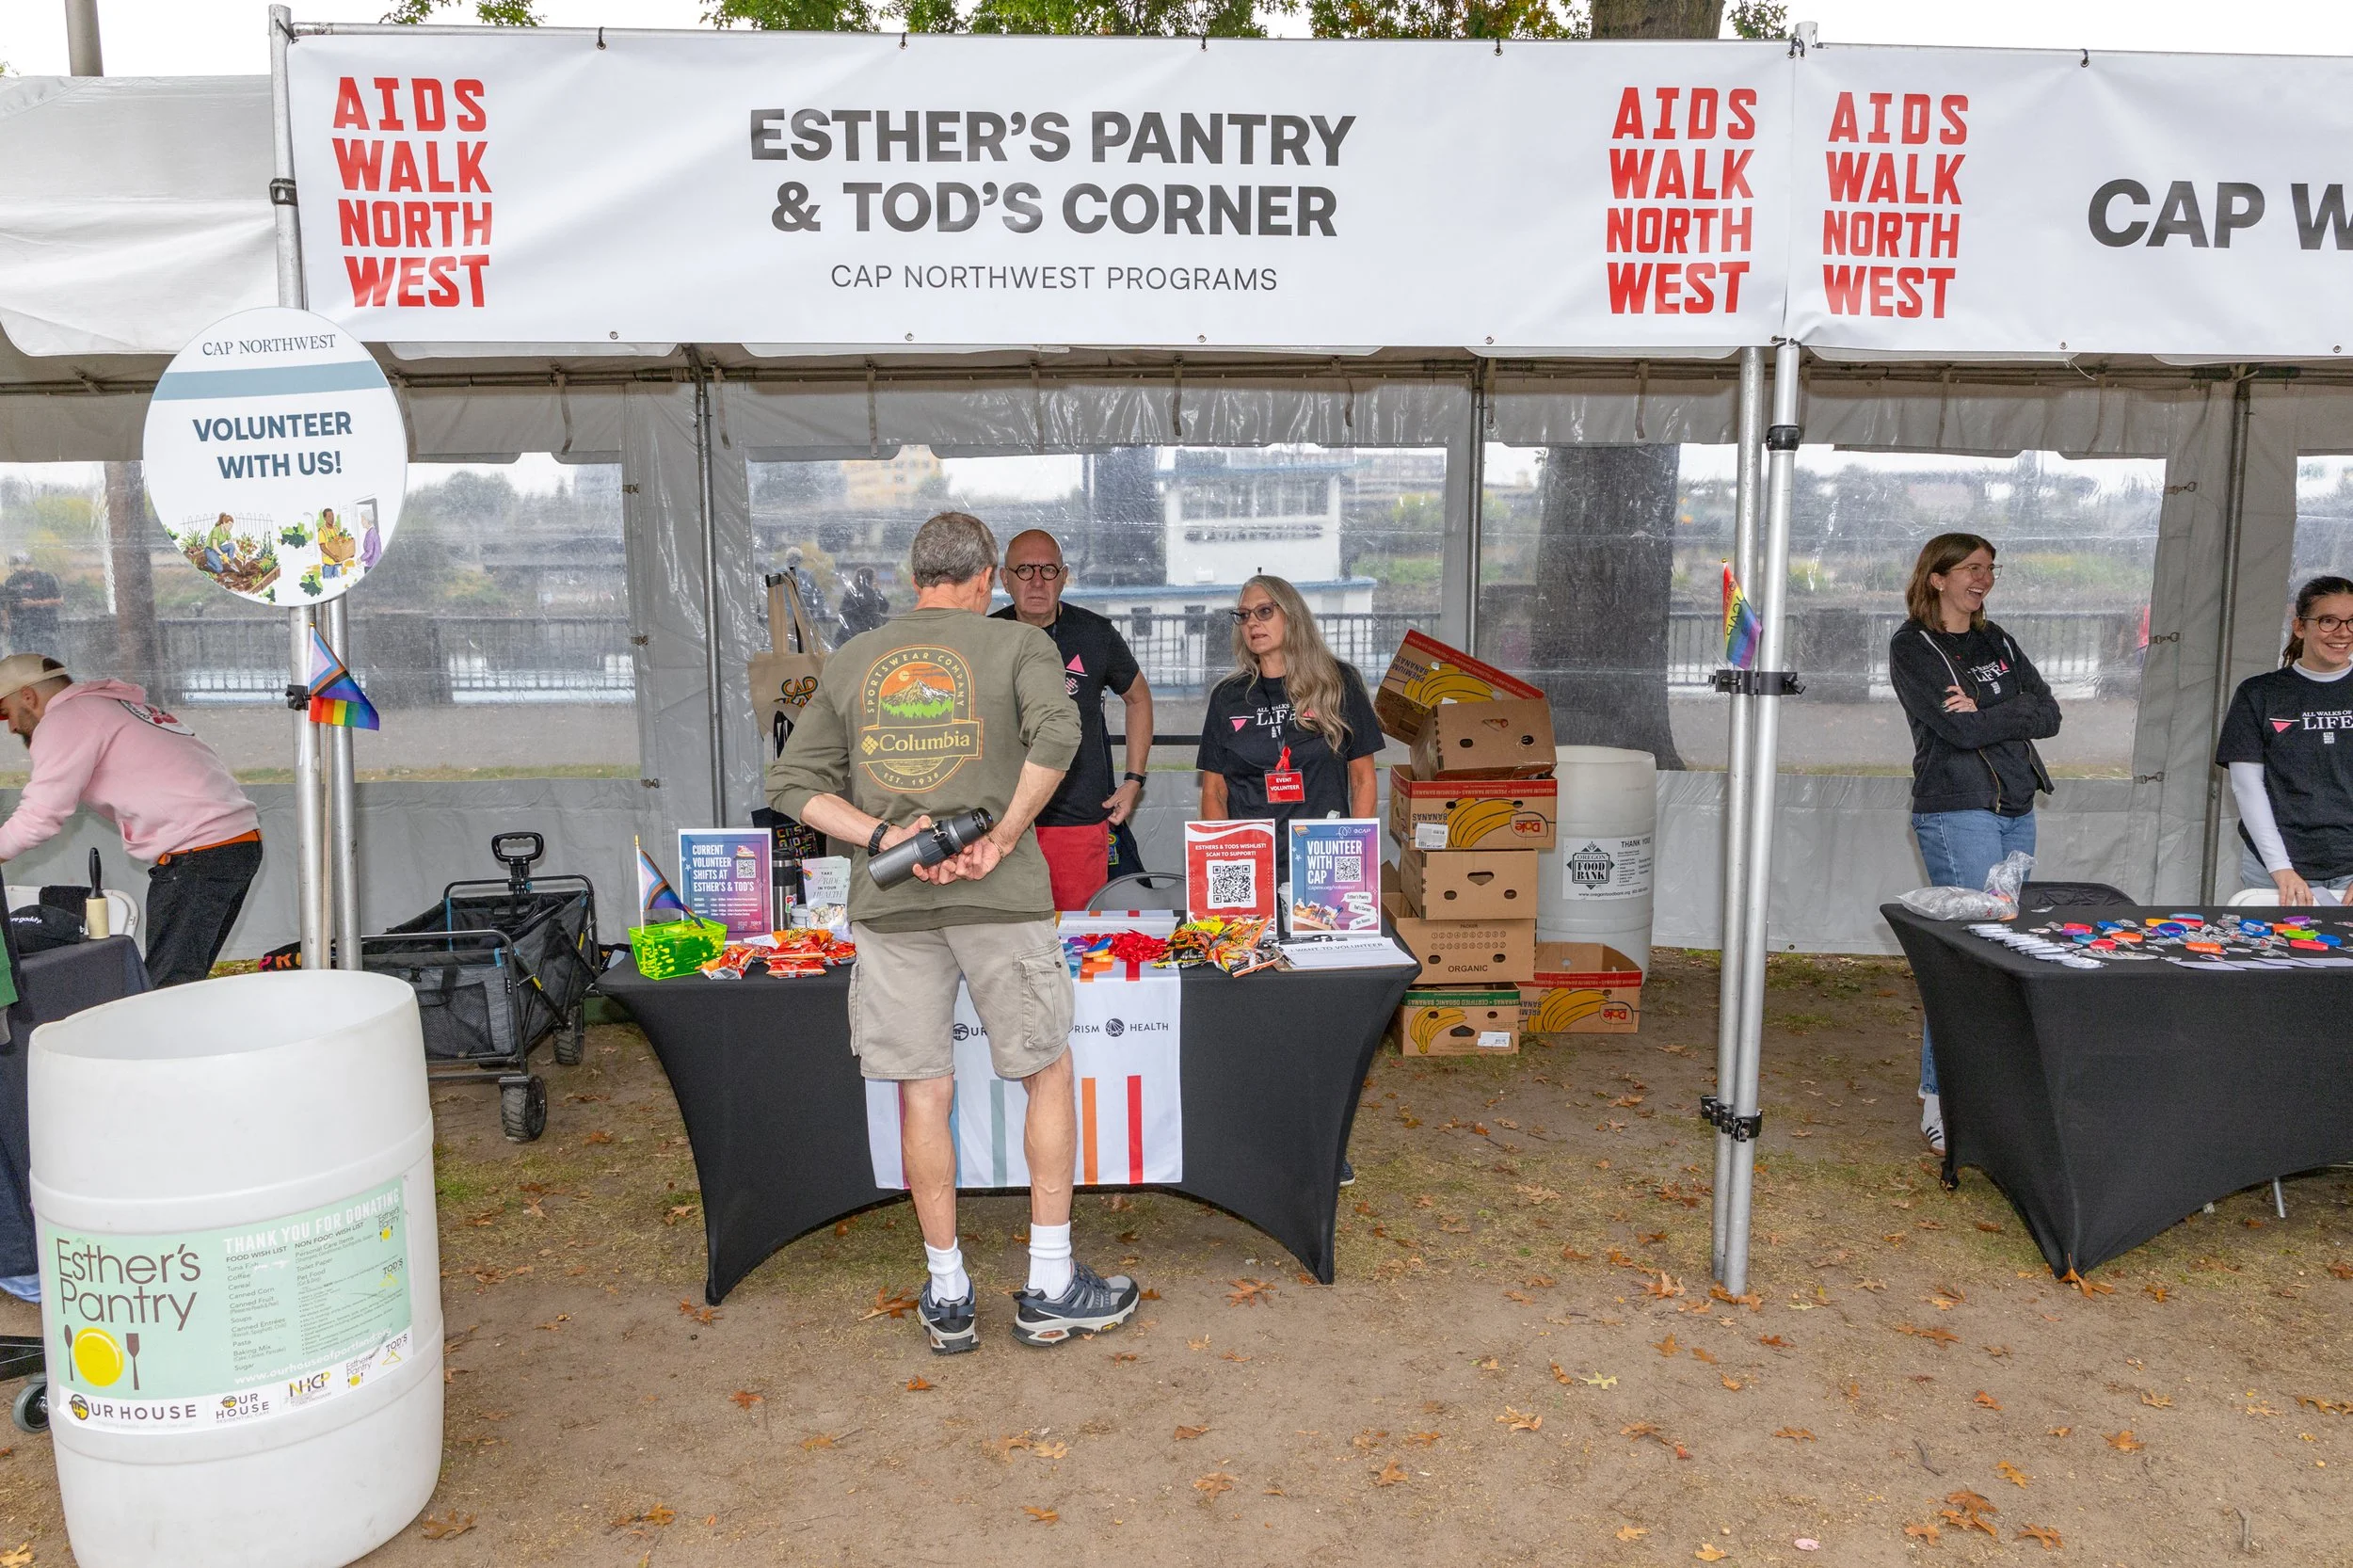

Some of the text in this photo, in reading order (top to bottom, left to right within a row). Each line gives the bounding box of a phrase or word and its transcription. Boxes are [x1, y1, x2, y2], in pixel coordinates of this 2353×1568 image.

[333, 77, 487, 132] AIDS
[1611, 87, 1758, 140] AIDS
[1828, 91, 1969, 145] AIDS
[750, 108, 1356, 167] ESTHER'S PANTRY
[332, 137, 492, 193] WALK
[1609, 148, 1754, 200] WALK
[1825, 151, 1967, 205] WALK
[771, 181, 1337, 237] & TOD'S CORNER
[2088, 179, 2266, 248] CAP
[338, 199, 492, 248] NORTH
[1607, 206, 1753, 254] NORTH
[1822, 210, 1961, 259] NORTH
[344, 254, 489, 308] WEST
[830, 264, 1278, 291] CAP NORTHWEST PROGRAMS
[1607, 261, 1750, 315] WEST
[1822, 264, 1957, 319] WEST
[202, 333, 337, 357] CAP NORTHWEST
[192, 411, 353, 442] VOLUNTEER
[217, 450, 343, 479] WITH US!
[867, 652, 965, 713] SPORTSWEAR COMPANY
[2303, 715, 2353, 730] LIFE
[879, 730, 970, 752] Columbia
[883, 773, 904, 786] EST.
[1514, 821, 1541, 833] Dole
[692, 844, 724, 856] CURRENT
[1306, 840, 1363, 856] VOLUNTEER
[1621, 840, 1641, 848] THANK
[693, 856, 731, 868] VOLUNTEER
[1306, 856, 1333, 870] WITH
[1577, 862, 1606, 871] FOOD
[693, 869, 728, 880] SHIFTS AT
[1307, 871, 1327, 885] CAP
[1577, 872, 1605, 880] BANK
[693, 881, 754, 892] ESTHER'S & TOD'S
[1448, 965, 1488, 973] ORGANIC
[1603, 1010, 1627, 1020] Dole
[1129, 1022, 1169, 1032] HEALTH
[224, 1187, 400, 1255] THANK YOU FOR DONATING
[295, 1240, 312, 1249] NON
[313, 1233, 334, 1244] FOOD
[335, 1226, 352, 1238] WISH
[352, 1222, 364, 1231] LIST
[56, 1238, 201, 1286] Esther's
[226, 1245, 288, 1263] FOOD WISH LIST
[382, 1257, 404, 1275] TOD'S
[227, 1272, 251, 1282] Coffee
[228, 1282, 251, 1291] Cereal
[229, 1287, 275, 1300] Canned Corn
[59, 1277, 198, 1331] Pantry
[230, 1300, 257, 1309] Canned
[230, 1316, 252, 1324] Soups
[231, 1323, 259, 1333] Canned
[233, 1344, 272, 1357] Baking Mix
[386, 1333, 408, 1353] TOD'S
[235, 1327, 392, 1385] www.ourhouseofportland.org
[234, 1363, 255, 1372] Sugar
[289, 1371, 331, 1398] NHCP
[120, 1404, 197, 1420] HOUSE
[216, 1400, 269, 1419] HOUSE
